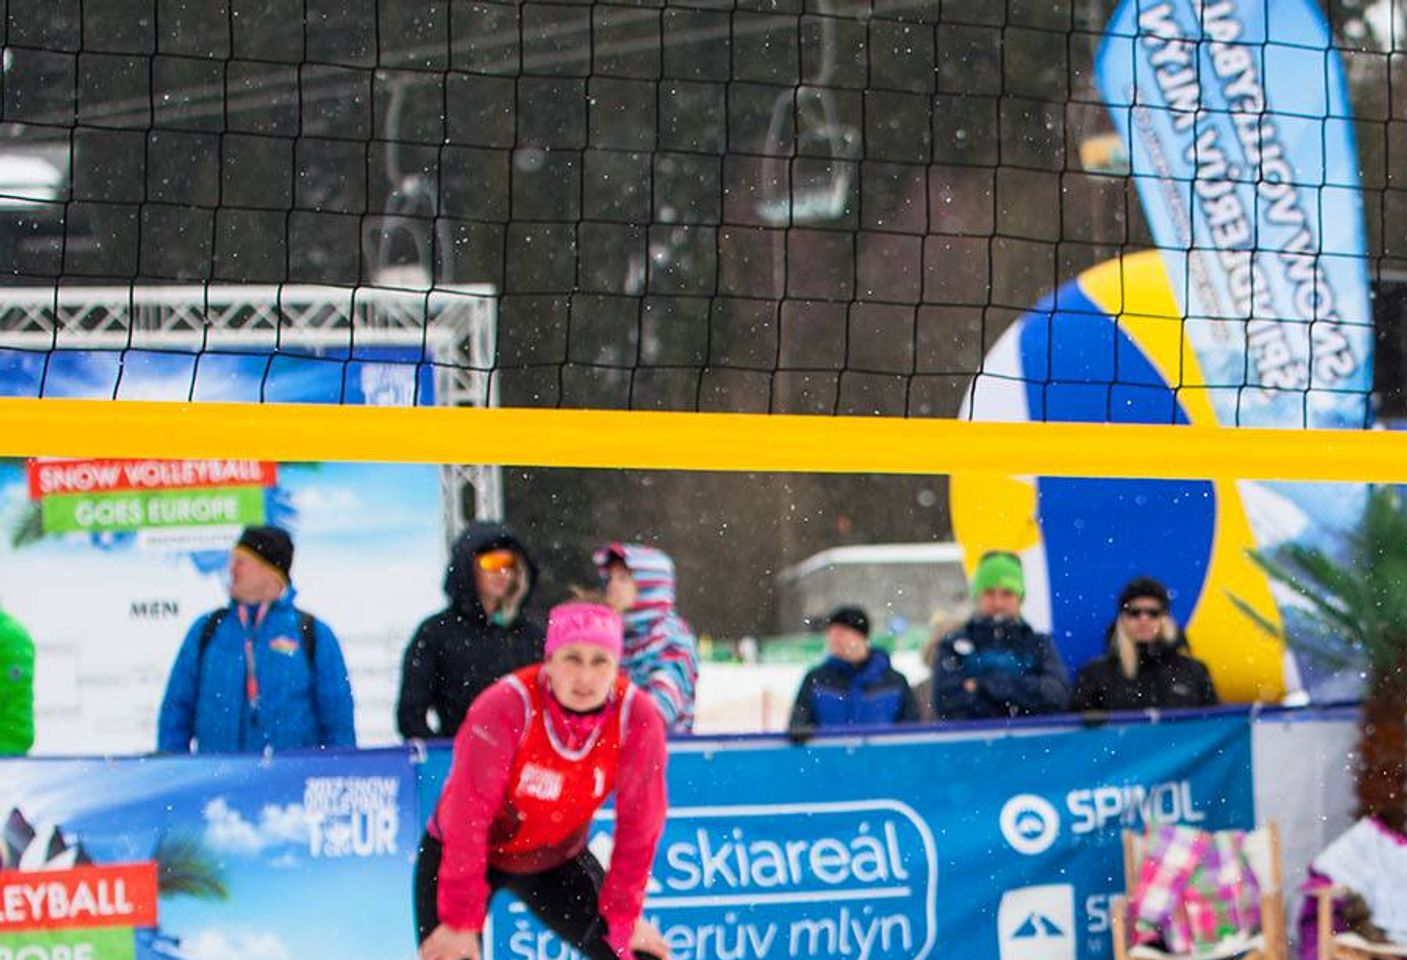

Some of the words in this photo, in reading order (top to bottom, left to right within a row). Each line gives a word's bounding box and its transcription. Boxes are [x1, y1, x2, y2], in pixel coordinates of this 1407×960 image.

[39, 463, 121, 493] SNOW
[124, 460, 263, 488] VOLLEYBALL
[75, 499, 143, 527] GOES
[150, 494, 240, 525] EUROPE
[129, 601, 179, 617] MEN
[666, 820, 910, 892] skiareál
[0, 878, 134, 922] EYBALL
